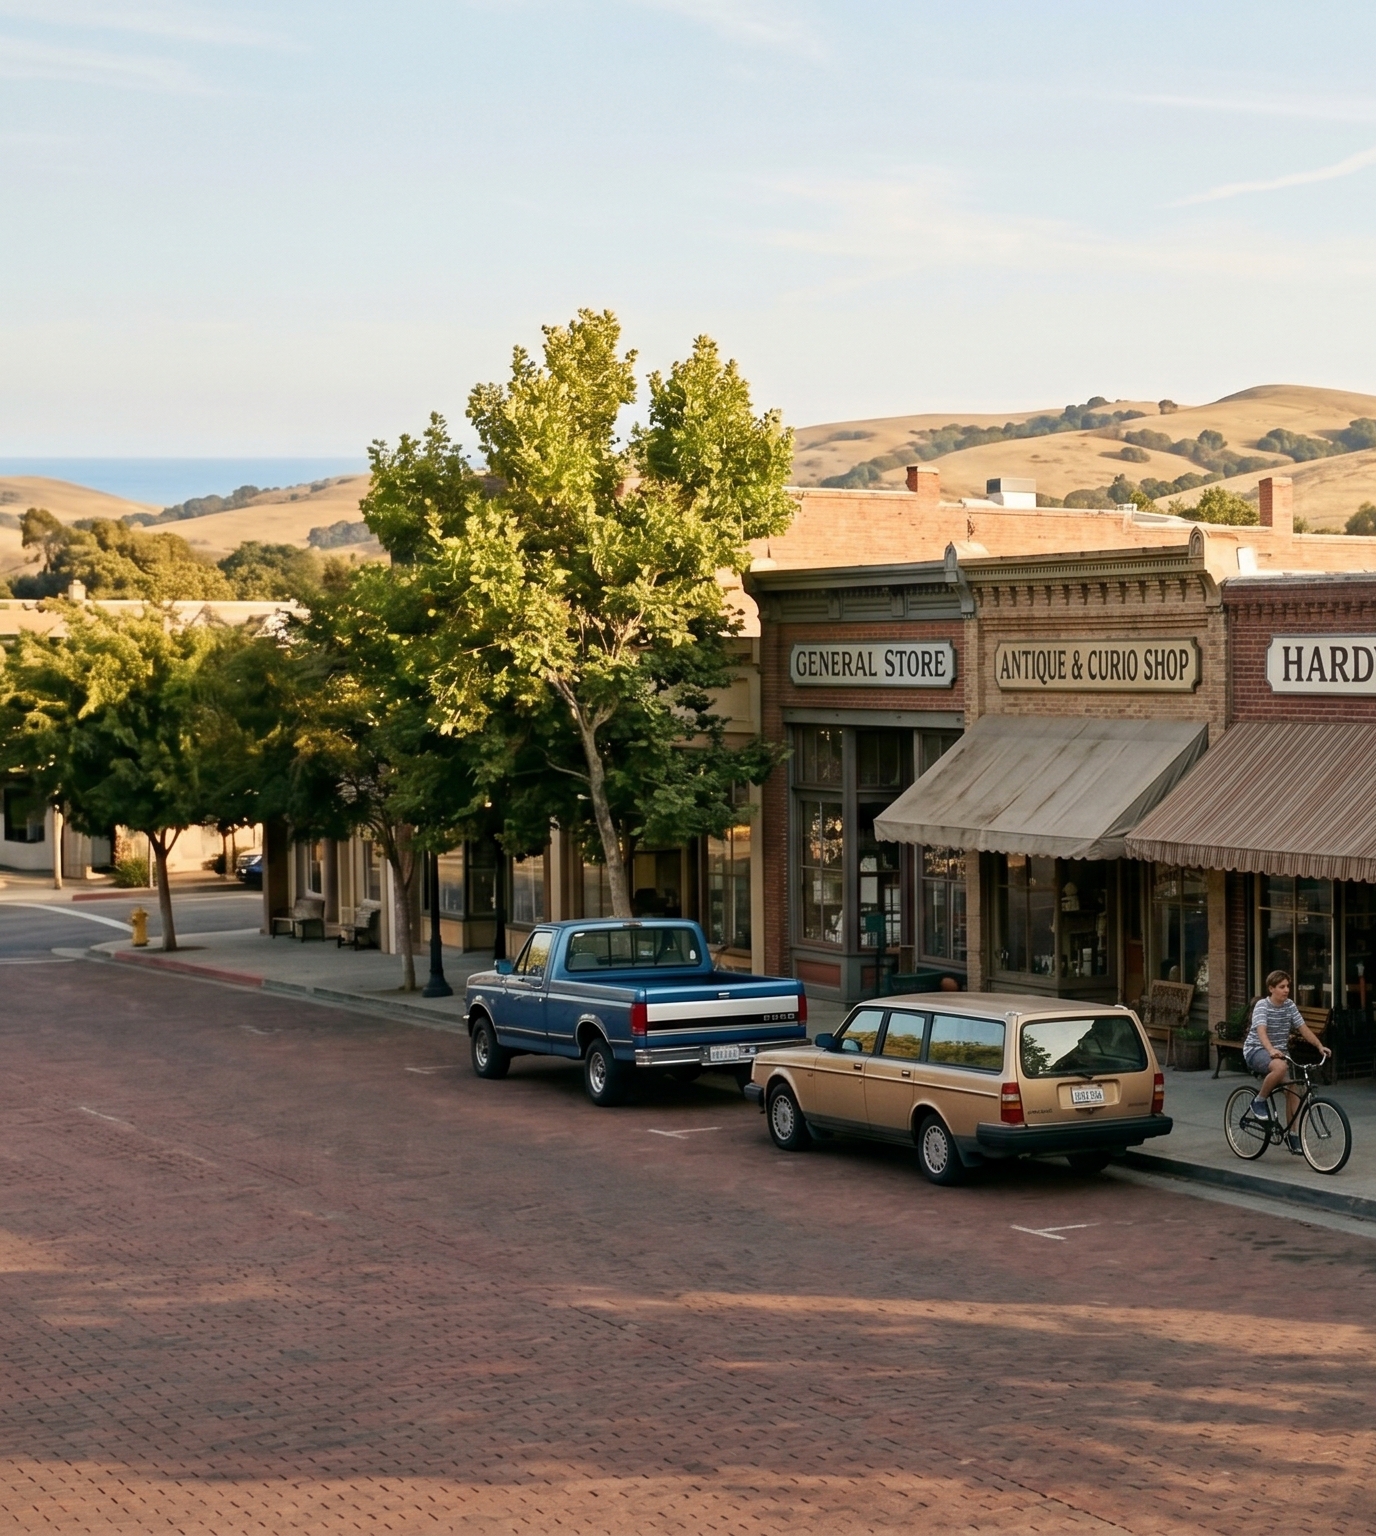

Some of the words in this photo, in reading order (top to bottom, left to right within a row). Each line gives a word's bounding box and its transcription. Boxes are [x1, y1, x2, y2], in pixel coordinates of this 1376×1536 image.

[796, 650, 877, 678] GENERAL
[884, 649, 946, 677] STORE
[1000, 648, 1067, 685] ANTIQUE
[1071, 649, 1084, 681] &
[1087, 648, 1138, 682] CURIO
[1143, 648, 1189, 681] SHOP
